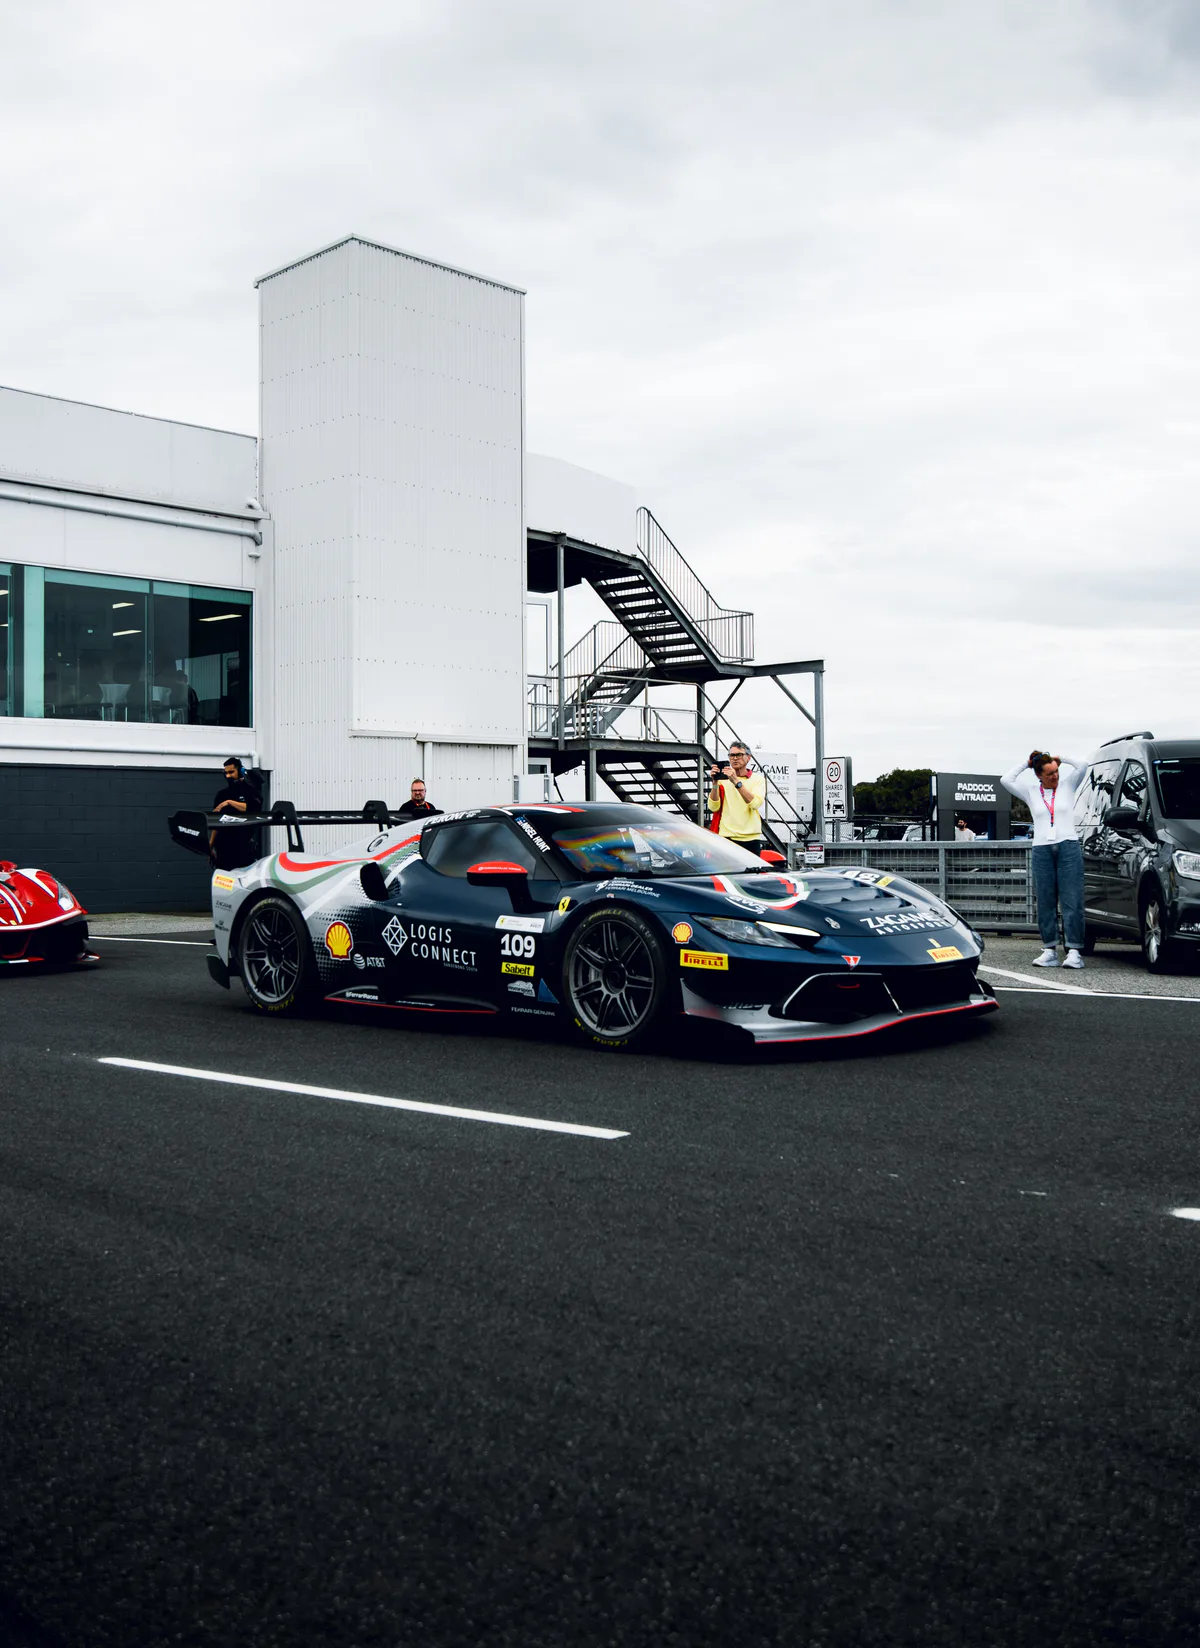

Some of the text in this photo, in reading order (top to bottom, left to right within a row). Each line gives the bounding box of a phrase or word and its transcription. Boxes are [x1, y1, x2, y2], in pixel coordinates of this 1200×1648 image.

[829, 767, 839, 776] 20
[957, 783, 993, 792] PADDOCK
[955, 793, 996, 801] ENTRANCE
[520, 821, 551, 853] NIGEL HUNT
[860, 912, 934, 929] ZAGAME
[410, 923, 452, 943] LOGIS
[501, 933, 535, 958] 109
[411, 942, 477, 966] CONNECT
[684, 952, 724, 967] PIRELLI
[366, 956, 386, 968] AT&T
[505, 963, 531, 975] Sabelt
